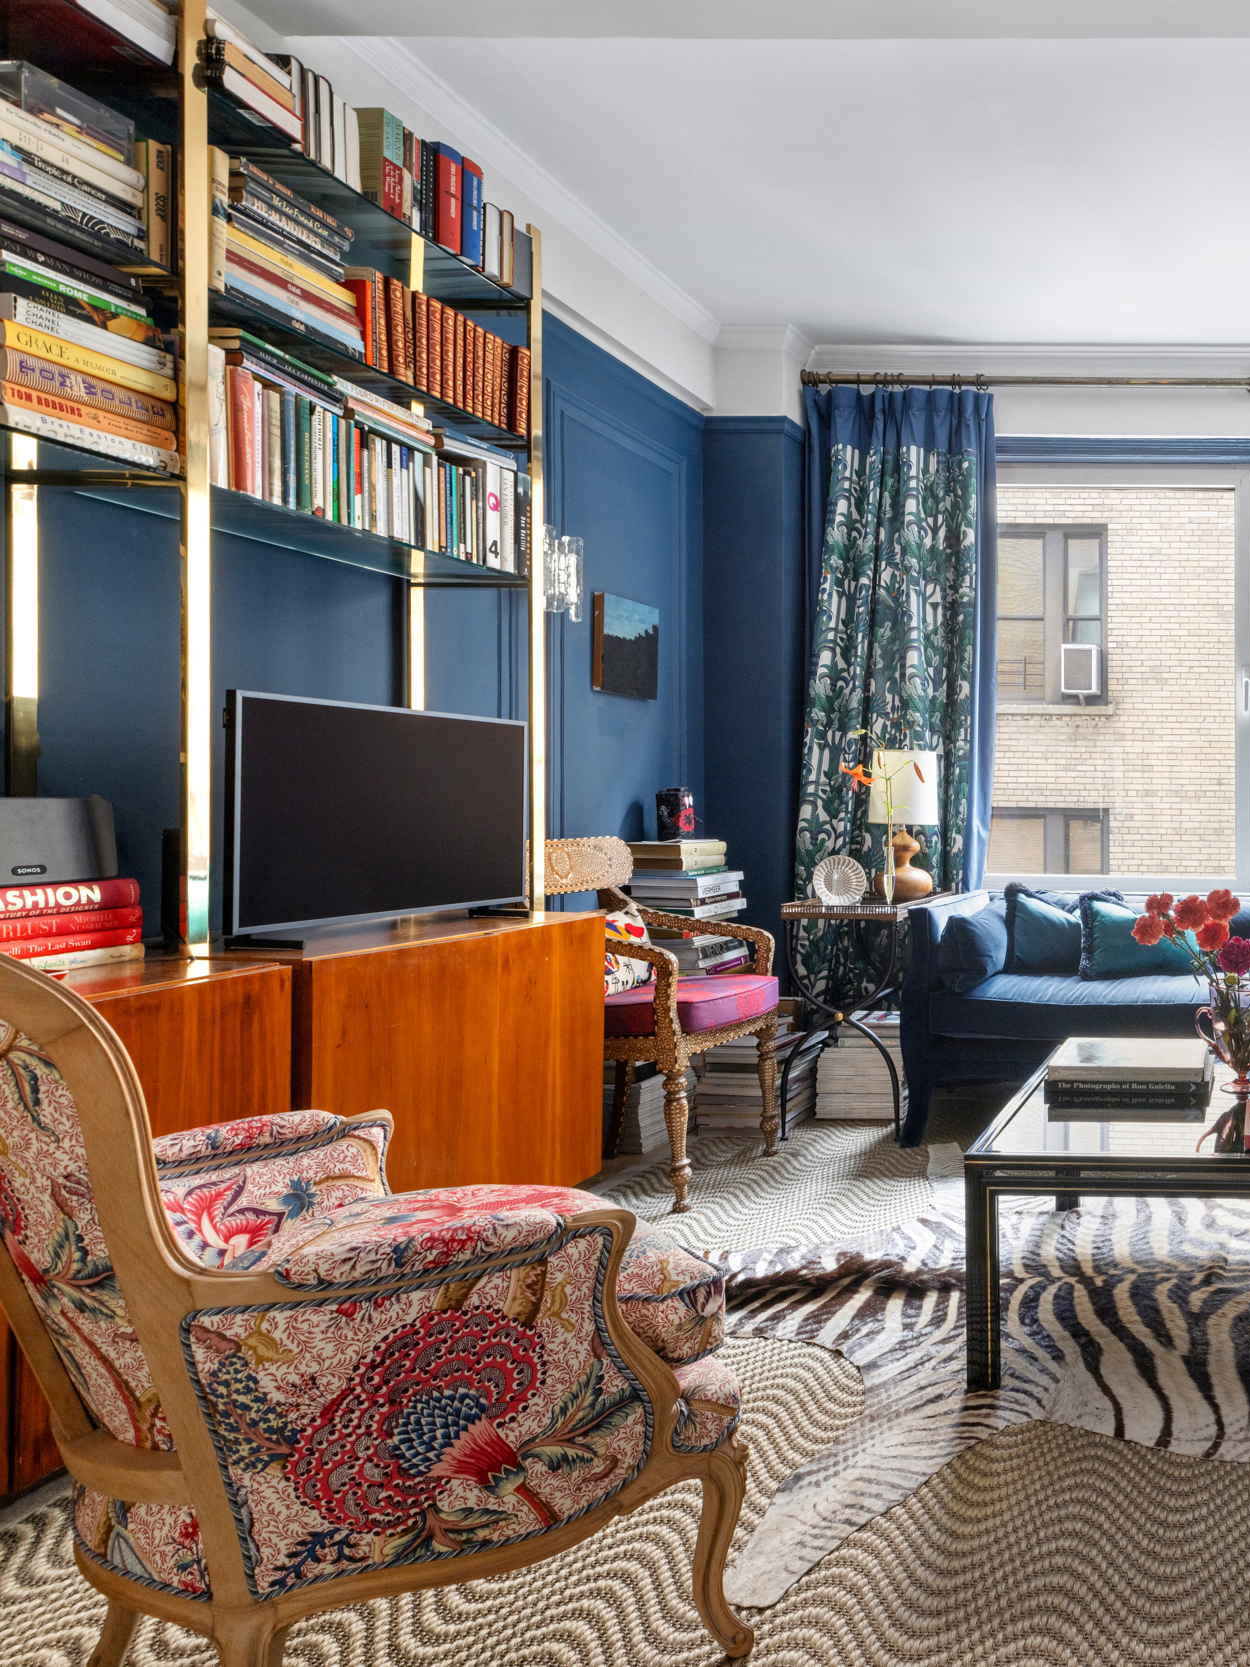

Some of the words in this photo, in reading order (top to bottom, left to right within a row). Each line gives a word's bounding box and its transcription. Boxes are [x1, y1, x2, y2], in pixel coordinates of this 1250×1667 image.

[384, 116, 391, 127] DE
[32, 154, 61, 180] Tropic
[72, 178, 106, 200] Cancer
[32, 180, 53, 194] MUSIC
[68, 198, 110, 220] CHAMELEONS
[294, 209, 314, 228] Frank
[314, 222, 330, 237] Case
[32, 275, 56, 288] DISCOVER
[59, 284, 90, 302] ROME
[26, 302, 62, 320] CHANEL
[26, 310, 62, 328] CHANEL
[26, 318, 61, 335] CHANEL
[17, 331, 70, 360] GRACE
[82, 359, 118, 377] MEMOIR
[296, 369, 328, 390] CARPENTER
[349, 383, 374, 401] FOURS
[10, 386, 33, 404] TOM
[36, 395, 83, 418] ROBBINS
[40, 416, 71, 431] Bret
[80, 428, 124, 446] Easton
[132, 442, 162, 458] Ellis
[487, 492, 500, 513] Q
[488, 540, 500, 558] 4
[702, 885, 721, 895] VERMEER
[60, 904, 100, 914] DESIGNER
[28, 944, 46, 953] The
[48, 940, 66, 950] Last
[68, 938, 92, 948] Swan
[1074, 1082, 1121, 1091] Photographs
[1148, 1082, 1176, 1090] Galella
